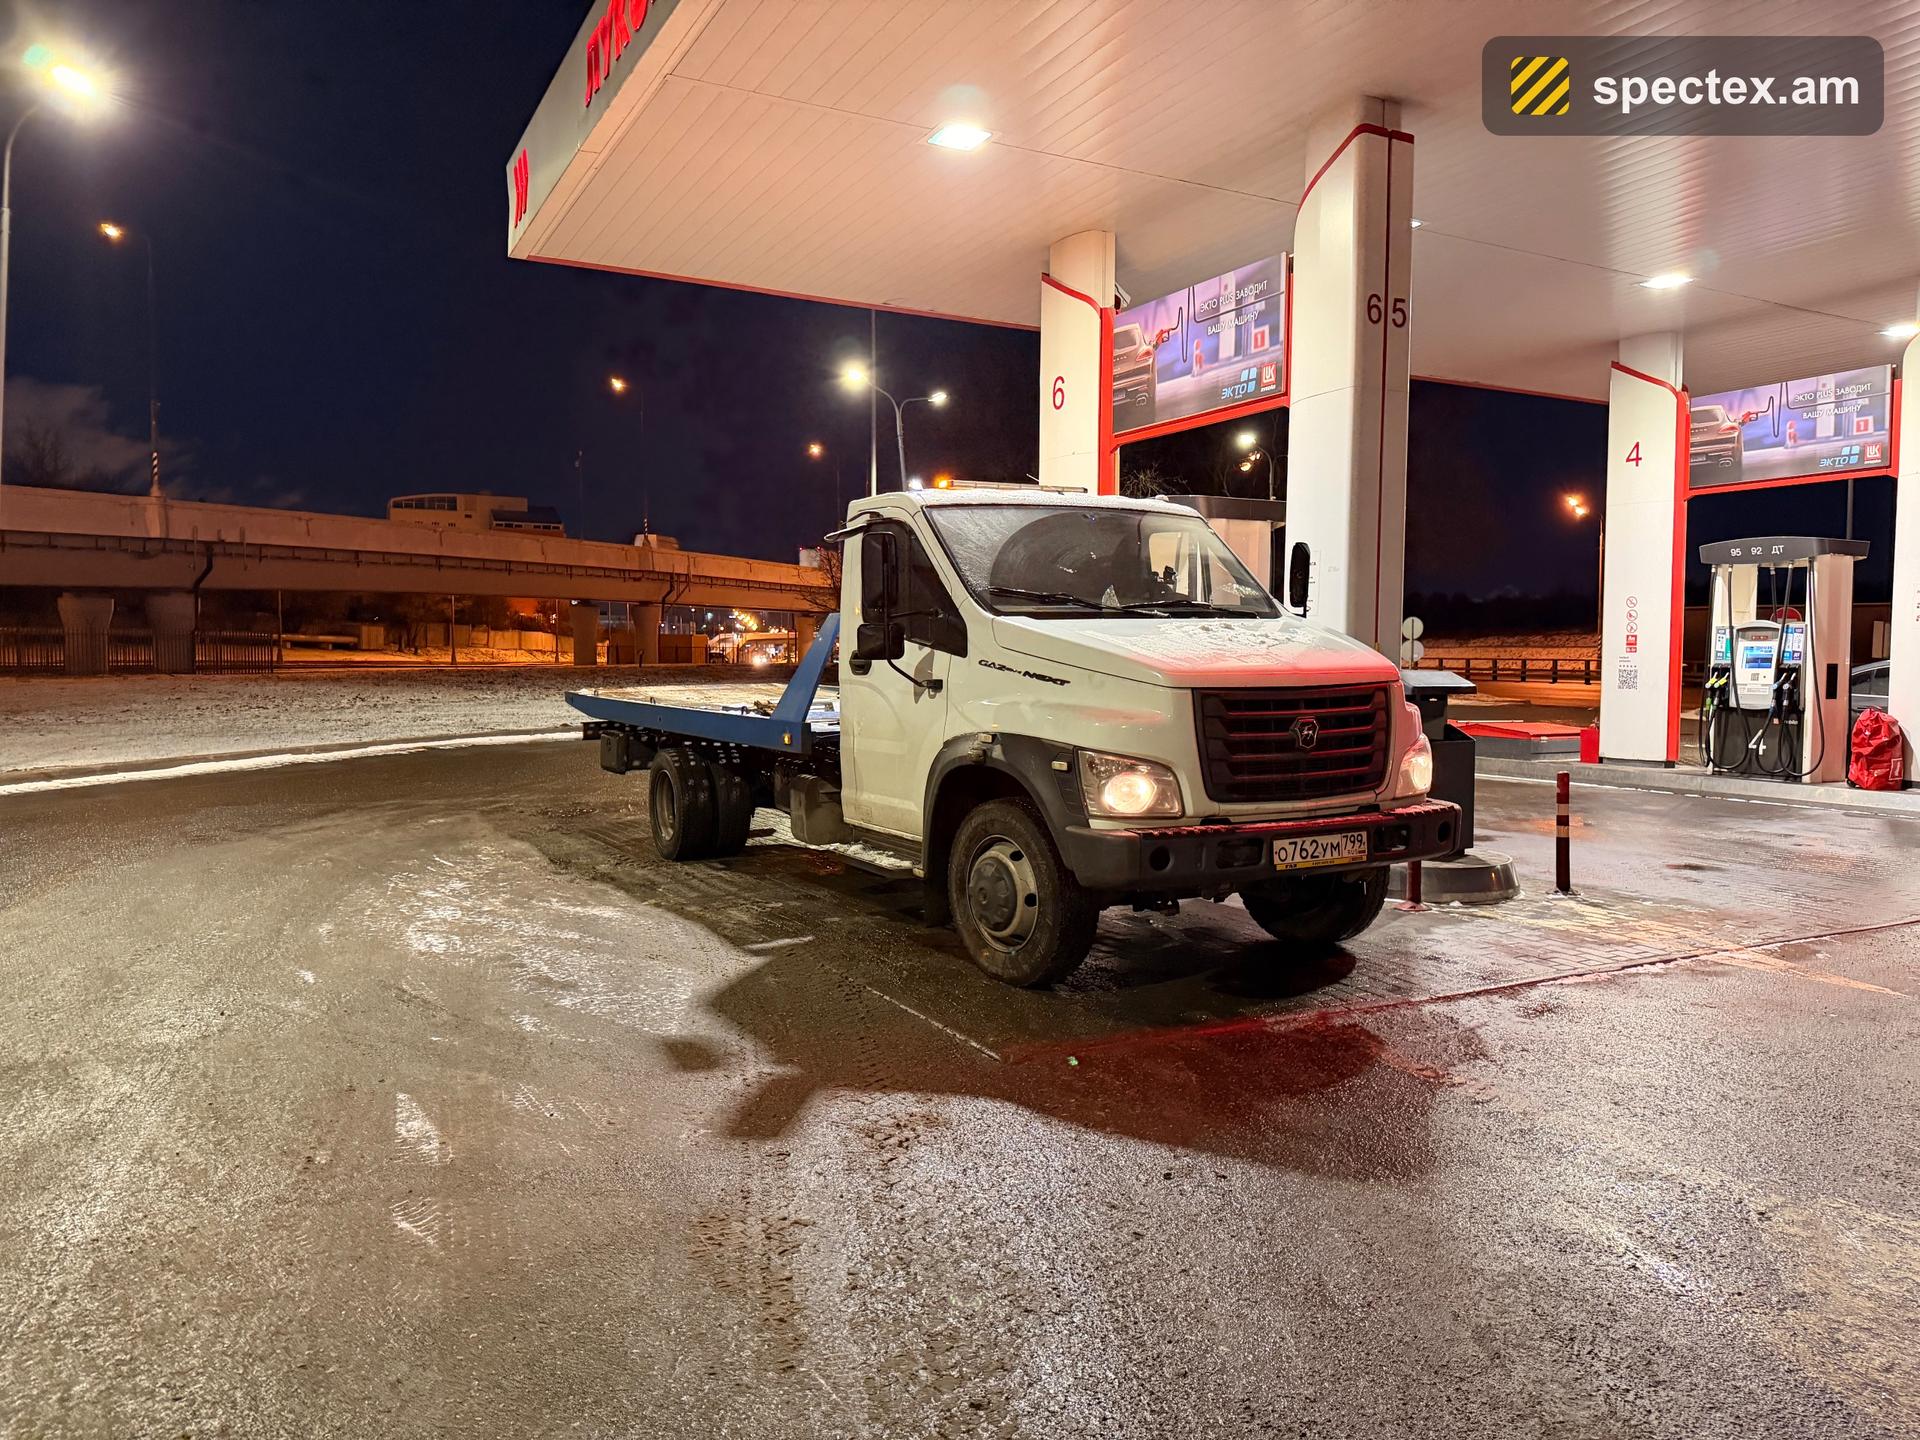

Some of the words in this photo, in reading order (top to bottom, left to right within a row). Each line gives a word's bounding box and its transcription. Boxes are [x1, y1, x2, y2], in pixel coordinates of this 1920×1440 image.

[1235, 280, 1267, 300] ЗАВОДИТ
[1367, 293, 1382, 325] 6
[1391, 297, 1407, 329] 5
[1052, 375, 1065, 411] 6
[1221, 383, 1247, 400] ЭКТО
[1794, 393, 1814, 402] ЭКТО
[1816, 389, 1833, 400] PLUS
[1835, 382, 1872, 396] ЗАВОДИТ
[1826, 404, 1862, 416] МАШИНУ
[1625, 441, 1643, 468] 4
[1819, 456, 1849, 467] ЭКТО
[1730, 548, 1742, 557] 95
[1750, 546, 1763, 556] 92
[1771, 544, 1785, 555] ДТ
[1022, 670, 1071, 686] NEXT
[1748, 729, 1767, 756] 4
[1278, 840, 1341, 862] О762УМ
[1342, 834, 1363, 851] 799
